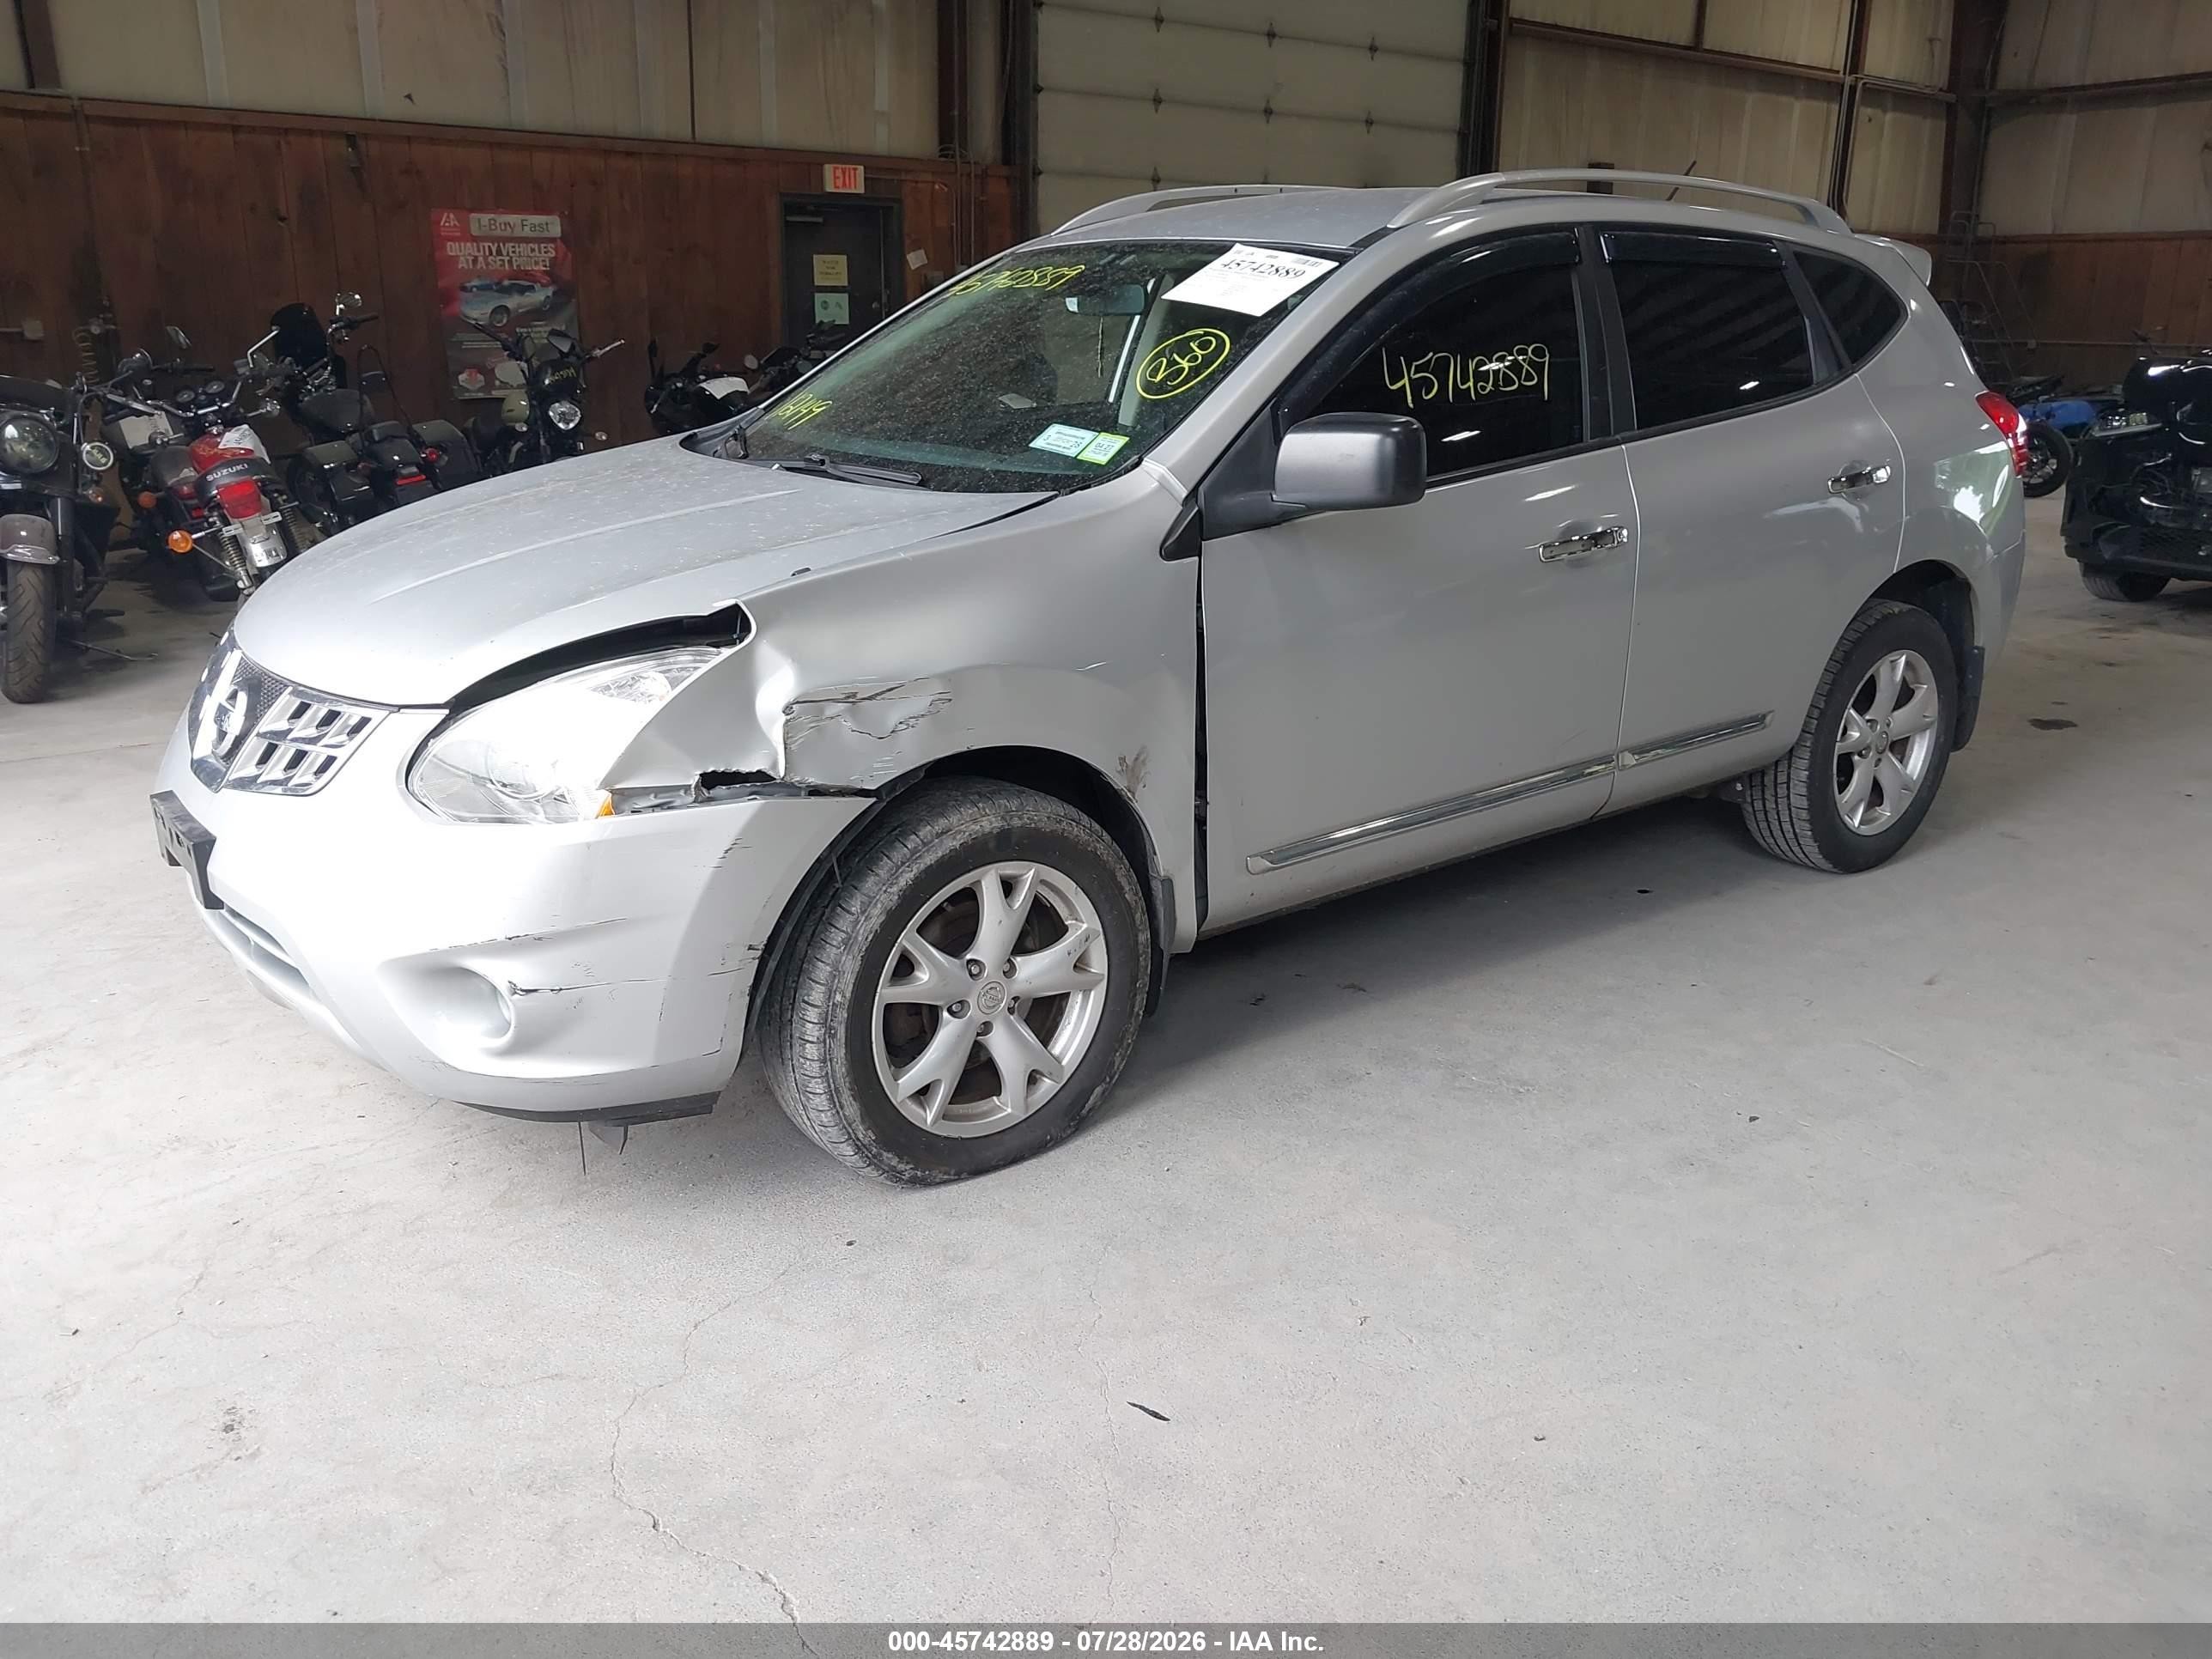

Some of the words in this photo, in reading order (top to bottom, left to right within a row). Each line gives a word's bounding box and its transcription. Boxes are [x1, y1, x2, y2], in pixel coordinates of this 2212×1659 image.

[831, 166, 859, 190] EXIT
[477, 217, 516, 234] I-Buy
[521, 219, 550, 233] Fast
[446, 241, 498, 256] QUALITY
[499, 242, 556, 257] VEHICLES
[458, 256, 476, 269] AT
[477, 256, 486, 270] A
[488, 257, 511, 270] SET
[511, 257, 550, 270] PRICE!
[1219, 258, 1307, 280] 45742889
[1381, 343, 1550, 410] 45742889
[205, 462, 249, 483] SUZUKI
